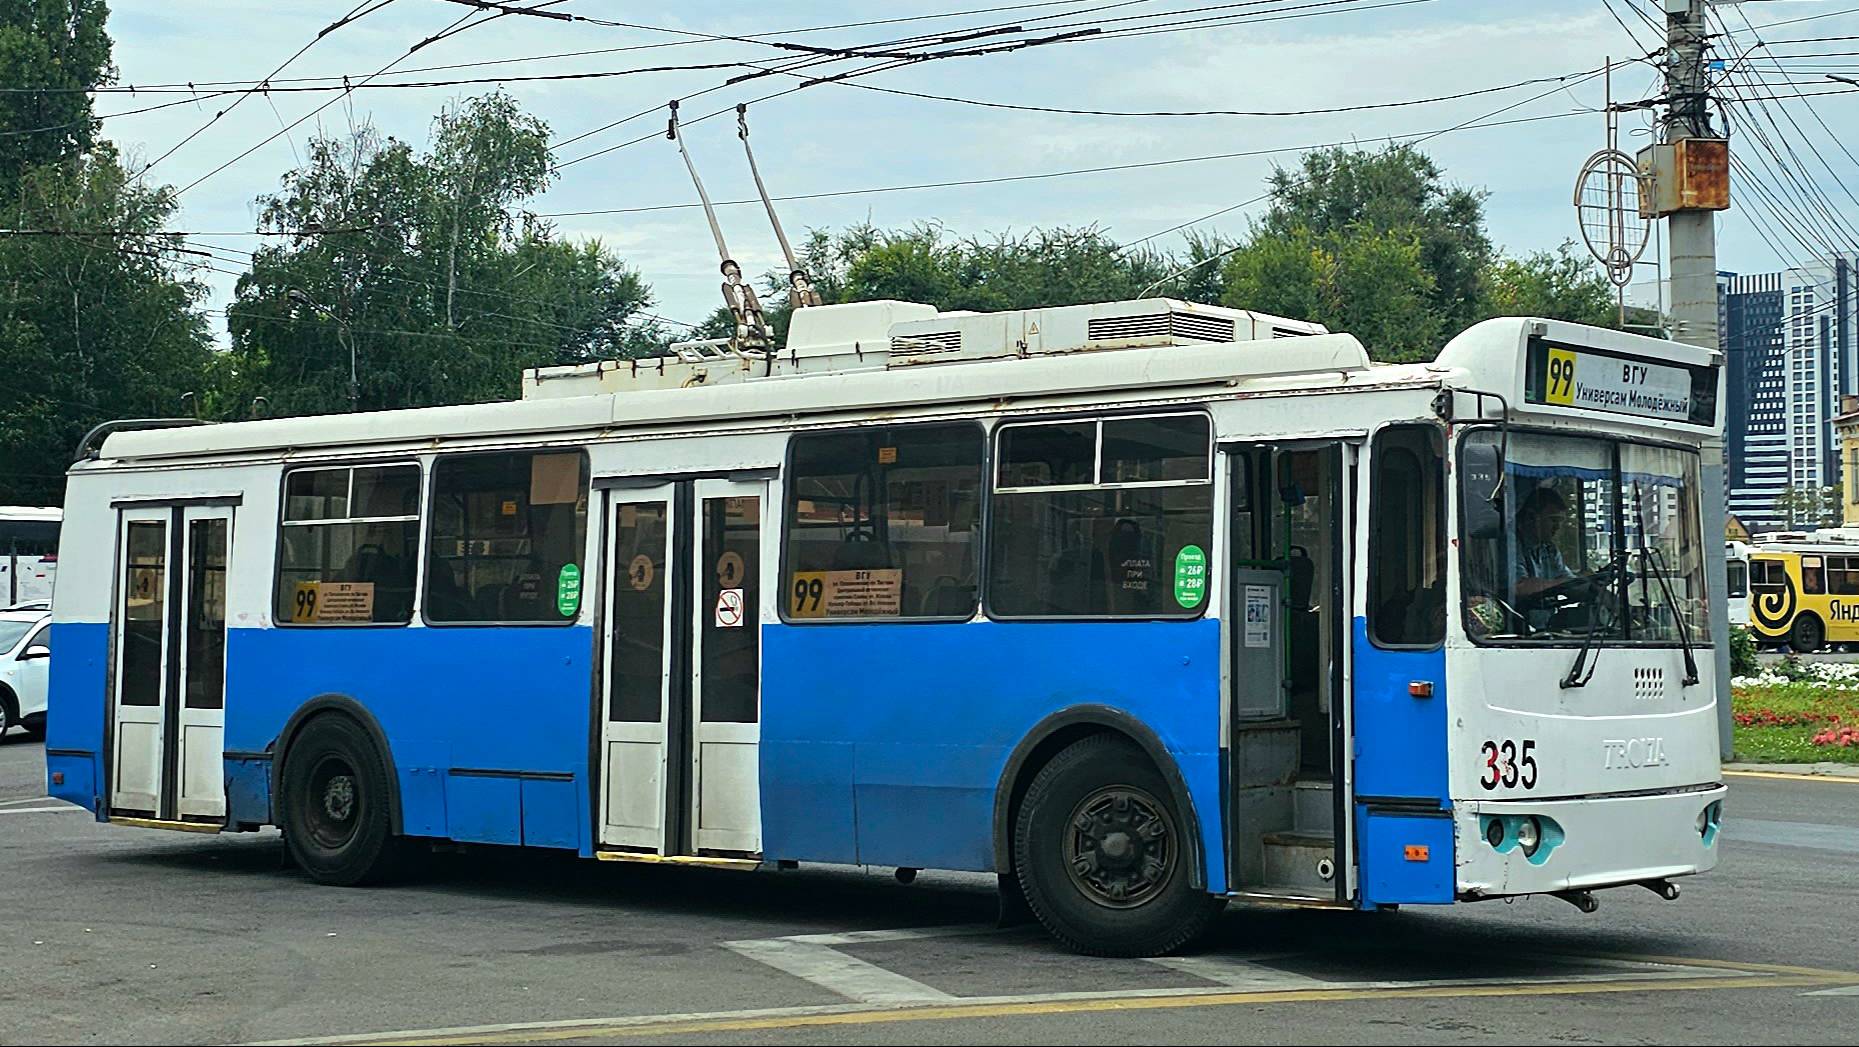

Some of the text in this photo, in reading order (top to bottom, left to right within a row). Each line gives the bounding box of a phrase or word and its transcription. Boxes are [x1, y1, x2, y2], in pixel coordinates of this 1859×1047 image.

[1550, 357, 1574, 397] 99
[1622, 364, 1648, 385] ВГУ
[1575, 381, 1688, 414] Универсам Молодёжный
[297, 589, 316, 617] 99
[795, 578, 823, 612] 99
[1480, 740, 1537, 790] 335
